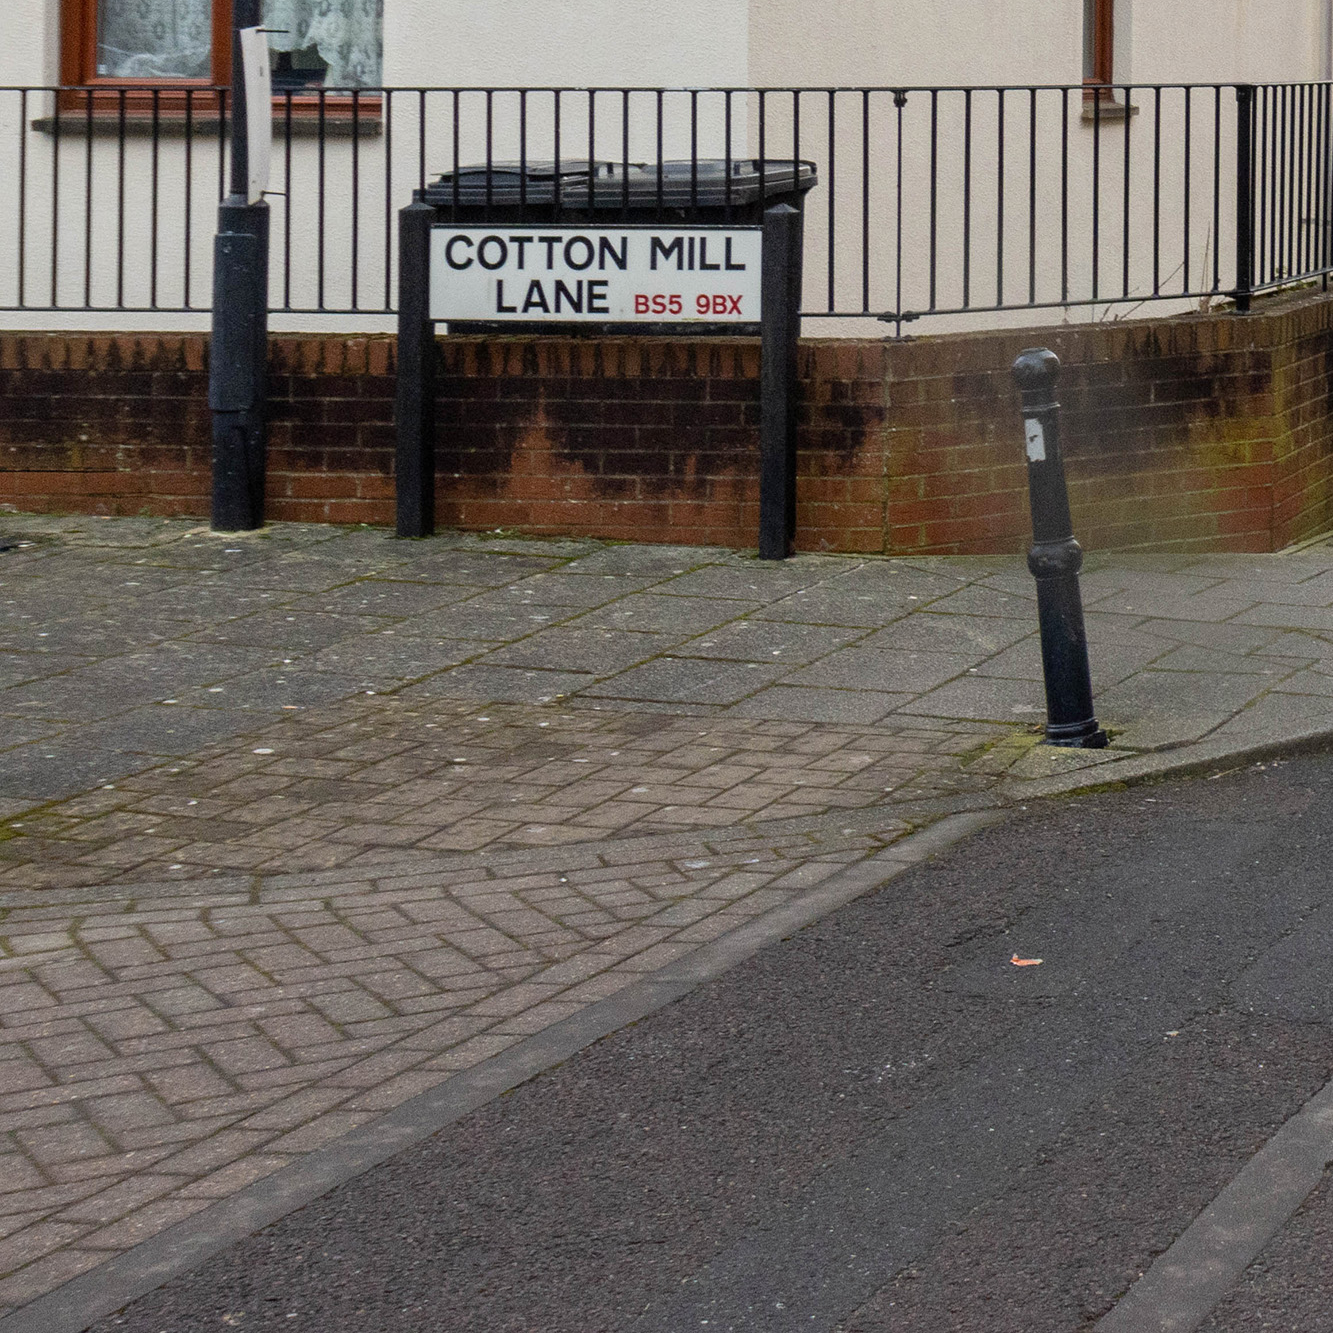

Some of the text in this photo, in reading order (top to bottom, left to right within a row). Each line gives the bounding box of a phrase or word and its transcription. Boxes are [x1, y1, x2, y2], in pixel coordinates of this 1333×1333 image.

[444, 234, 746, 271] COTTON MILL
[496, 279, 743, 315] LANE BS5 9BX
